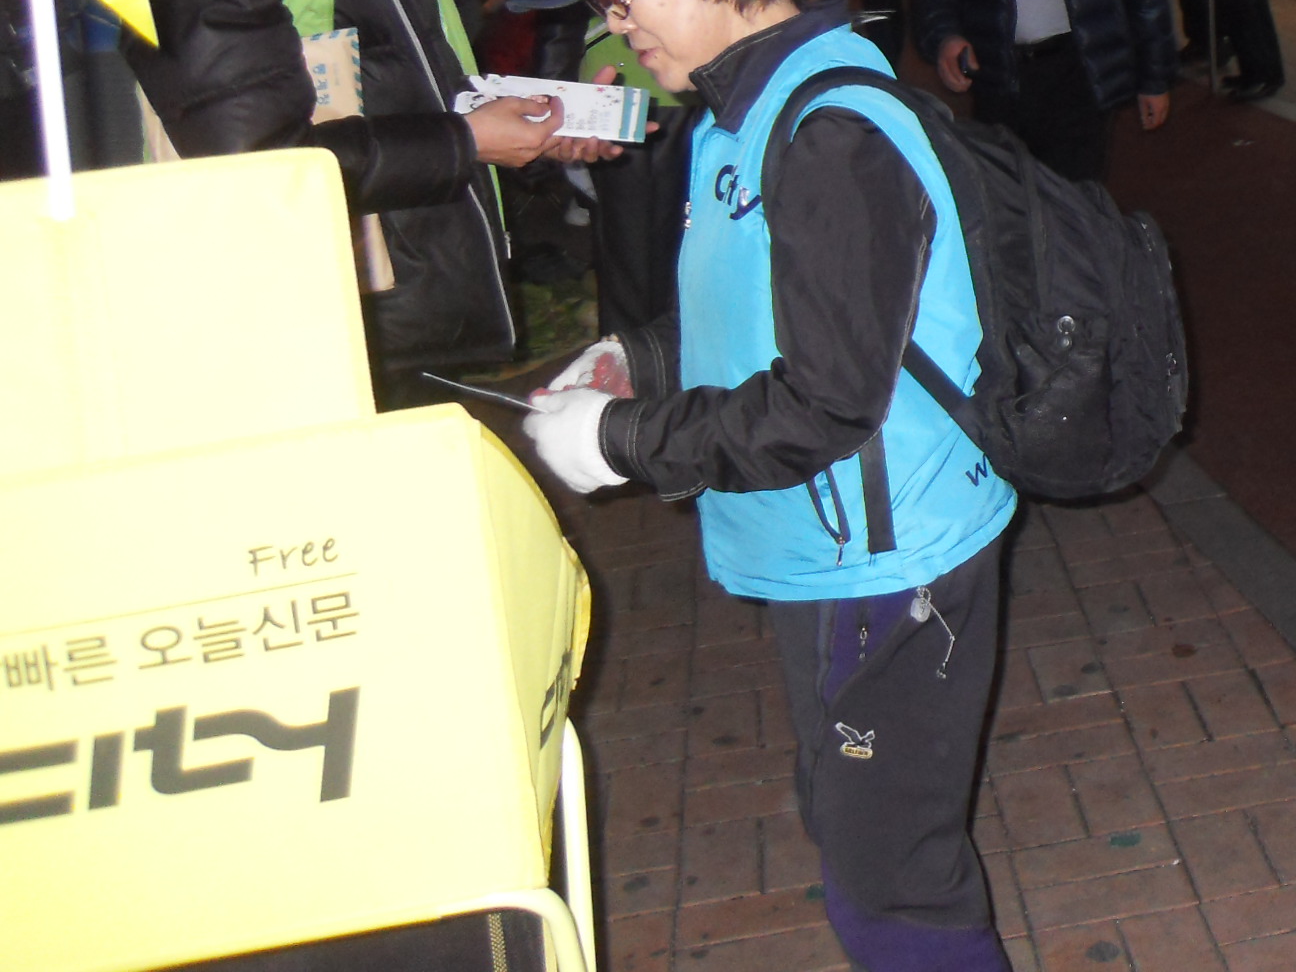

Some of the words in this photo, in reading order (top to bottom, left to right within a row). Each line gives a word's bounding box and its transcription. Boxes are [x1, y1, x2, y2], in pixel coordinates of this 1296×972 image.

[247, 536, 339, 576] Free
[1, 634, 117, 691] 빠른
[138, 590, 360, 672] 오늘신문
